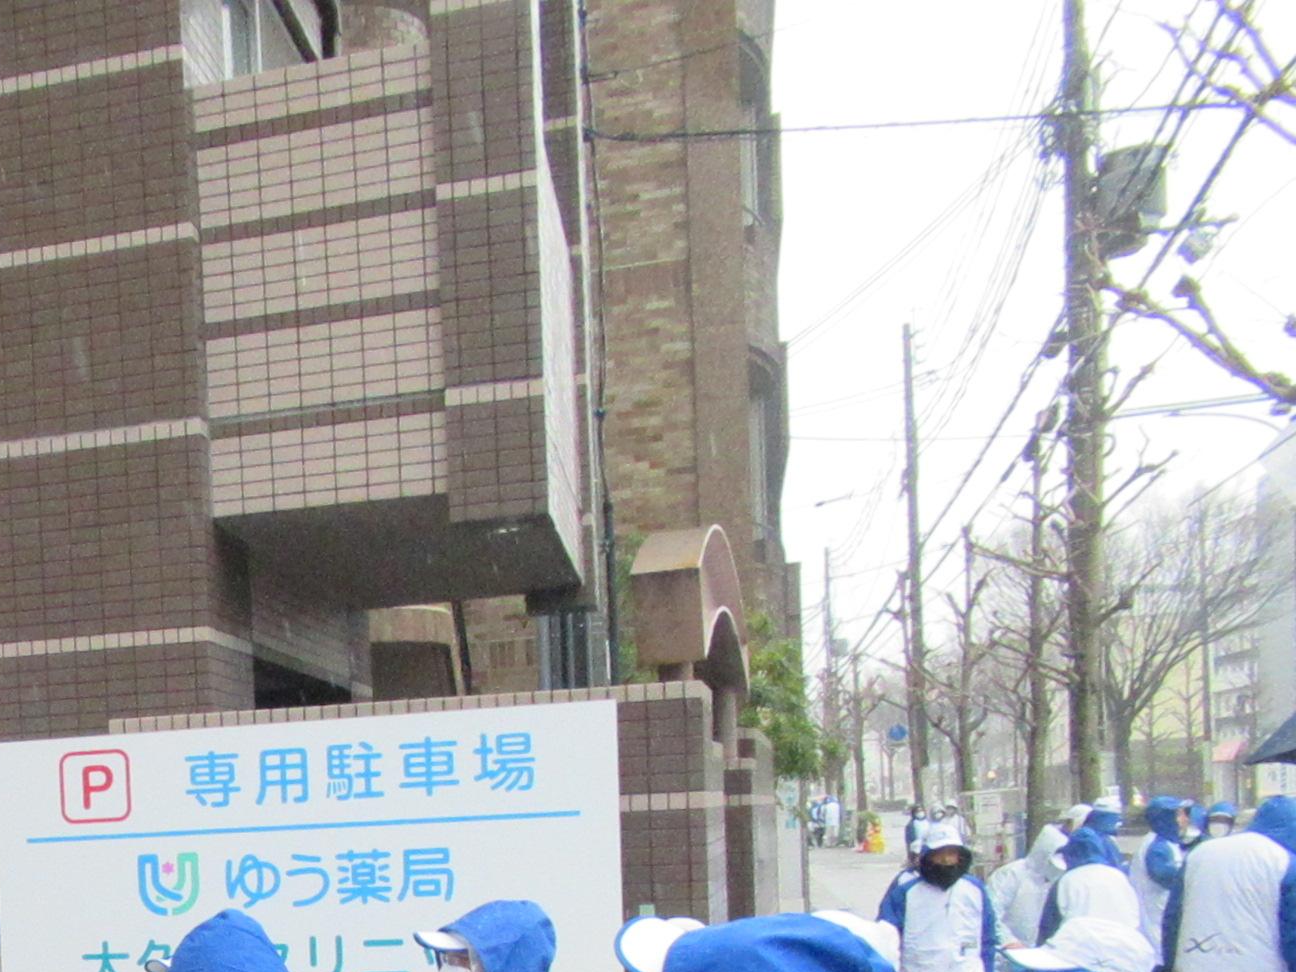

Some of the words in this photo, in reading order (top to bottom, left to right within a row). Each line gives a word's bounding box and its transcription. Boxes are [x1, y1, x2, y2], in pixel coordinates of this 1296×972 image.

[184, 731, 538, 808] 専用駐車場
[225, 846, 455, 909] ゆう薬局
